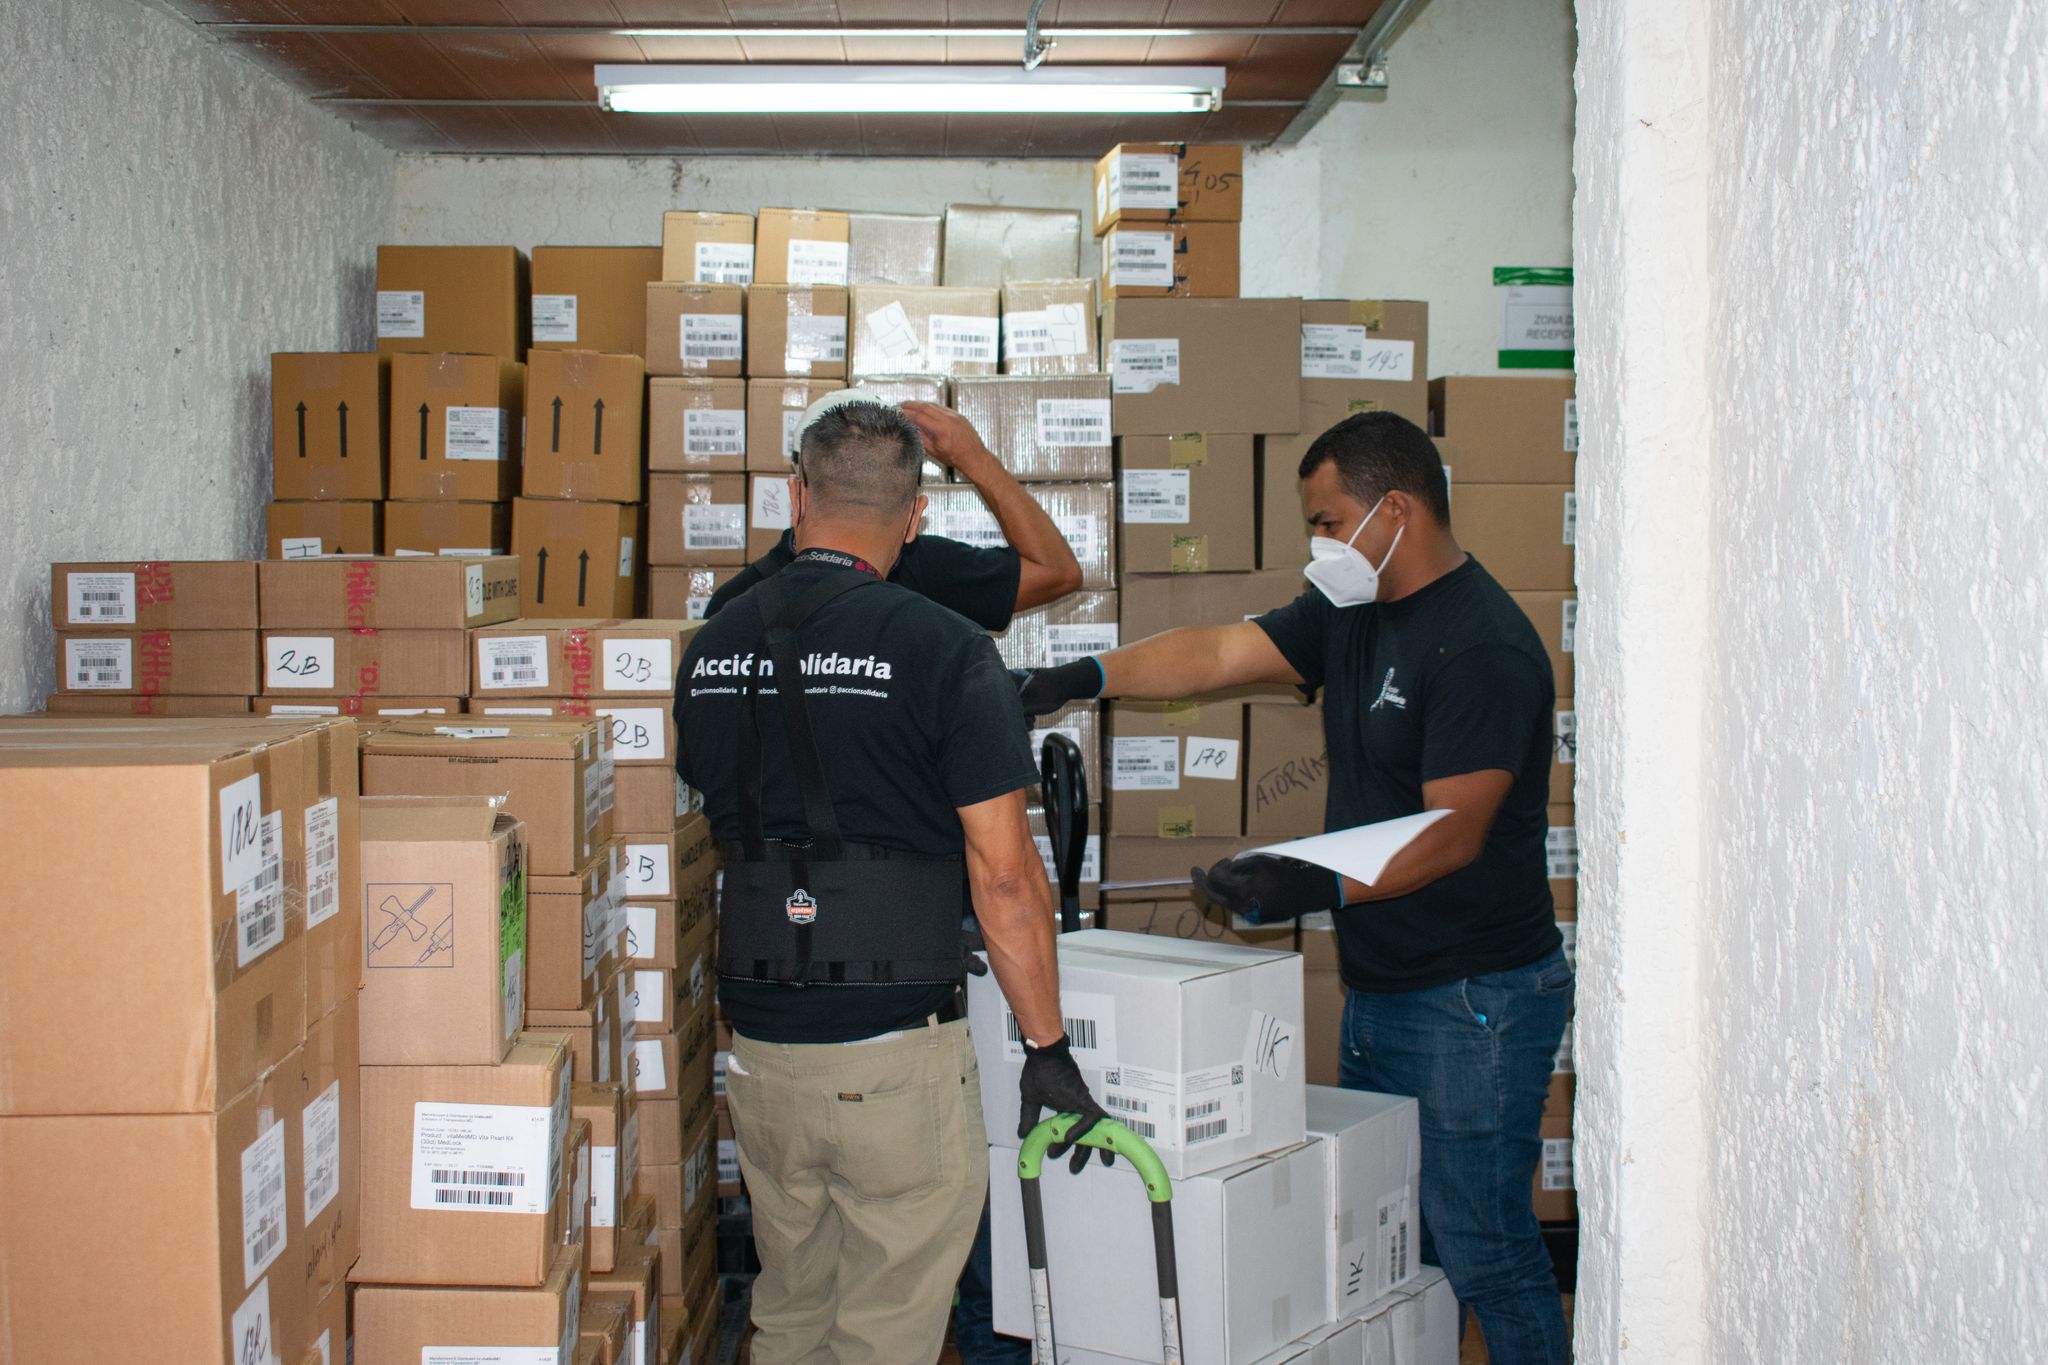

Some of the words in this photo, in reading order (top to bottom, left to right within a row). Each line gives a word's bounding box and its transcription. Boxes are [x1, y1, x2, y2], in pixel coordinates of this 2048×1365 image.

[277, 649, 320, 676] 2B
[615, 652, 652, 682] 2B
[800, 652, 892, 679] lidaria
